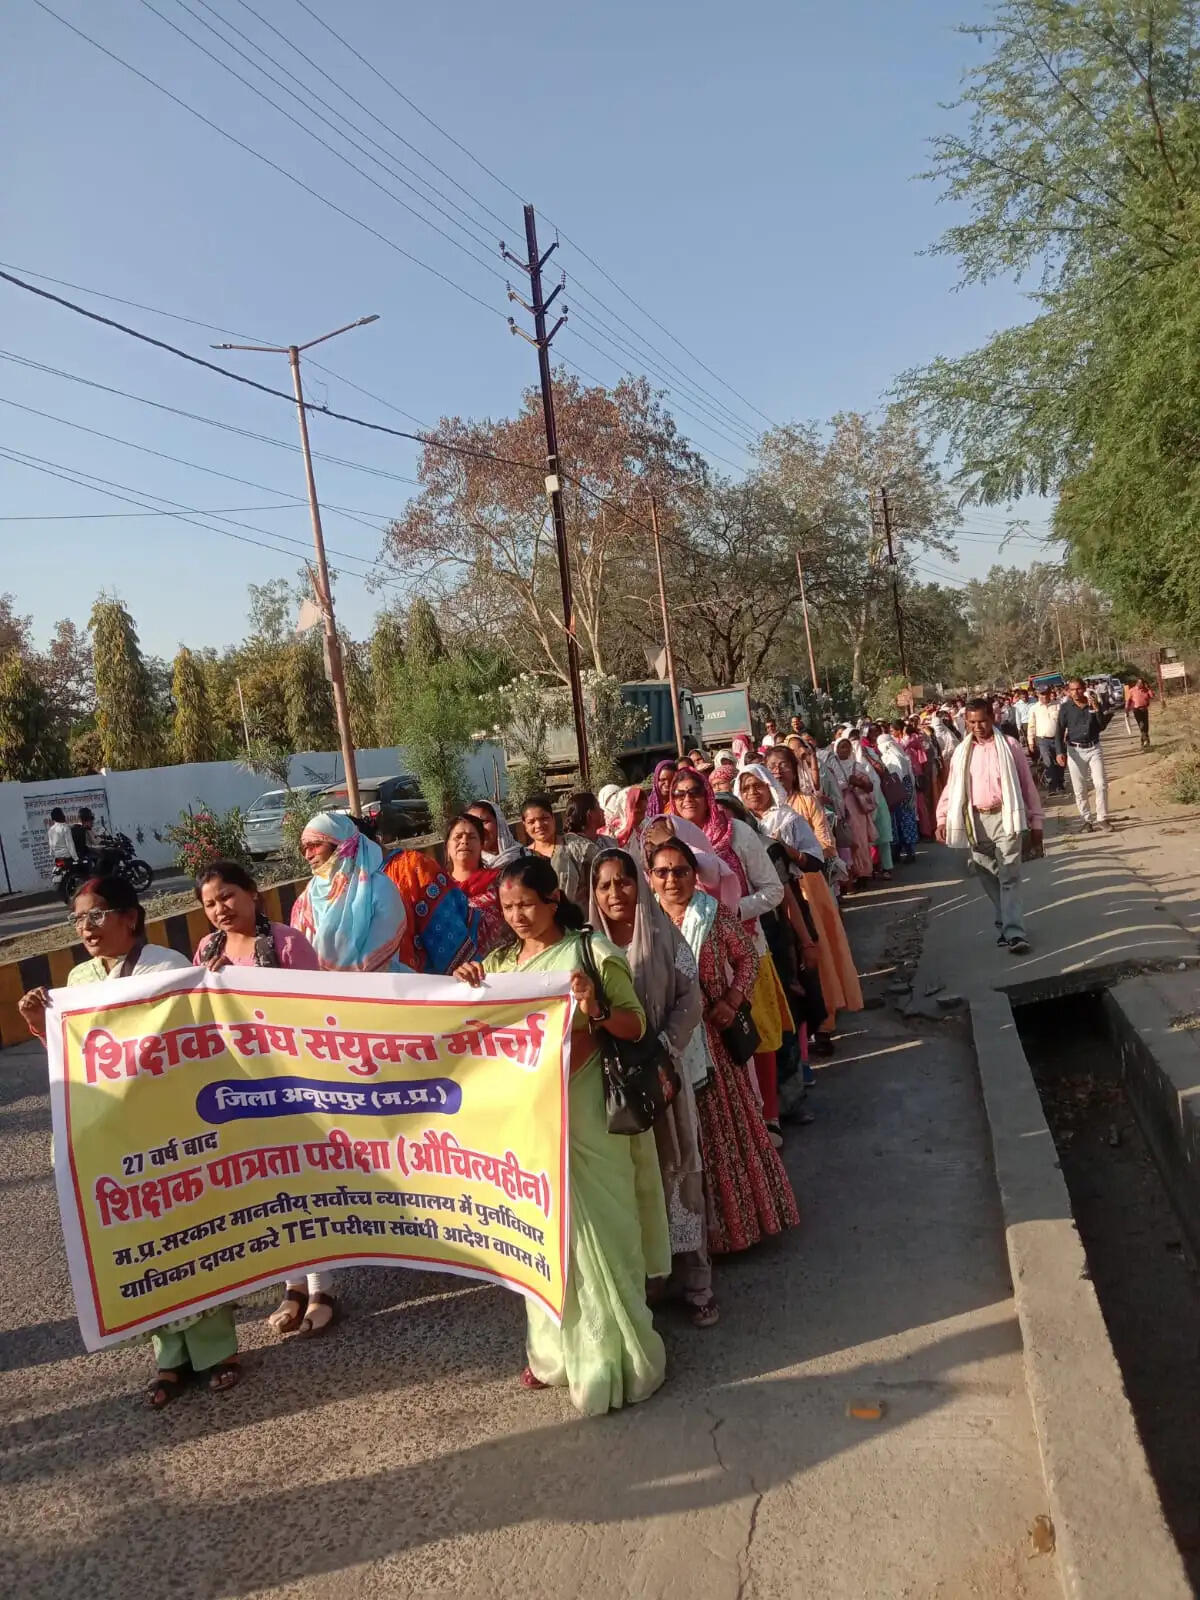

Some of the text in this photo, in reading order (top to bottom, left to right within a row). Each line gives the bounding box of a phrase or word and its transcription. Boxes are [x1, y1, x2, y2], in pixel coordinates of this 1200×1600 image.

[82, 1010, 546, 1084] शिक्षक संघ संयुक्त मोर्चा
[215, 1085, 447, 1110] जिला अनूपपुर (म.प्र.)
[96, 1129, 551, 1226] शिक्षक पात्रता परीक्षा (औचित्यहीन)
[122, 1131, 218, 1175] 27 वर्ष बाद
[311, 1186, 372, 1208] सर्वोच्च
[375, 1191, 455, 1212] न्यायालय
[458, 1194, 473, 1216] में
[120, 1260, 196, 1298] याचिका
[199, 1242, 246, 1272] दायर
[390, 1215, 439, 1240] संबंधी
[443, 1223, 490, 1249] आदेश
[492, 1237, 532, 1267] वापस
